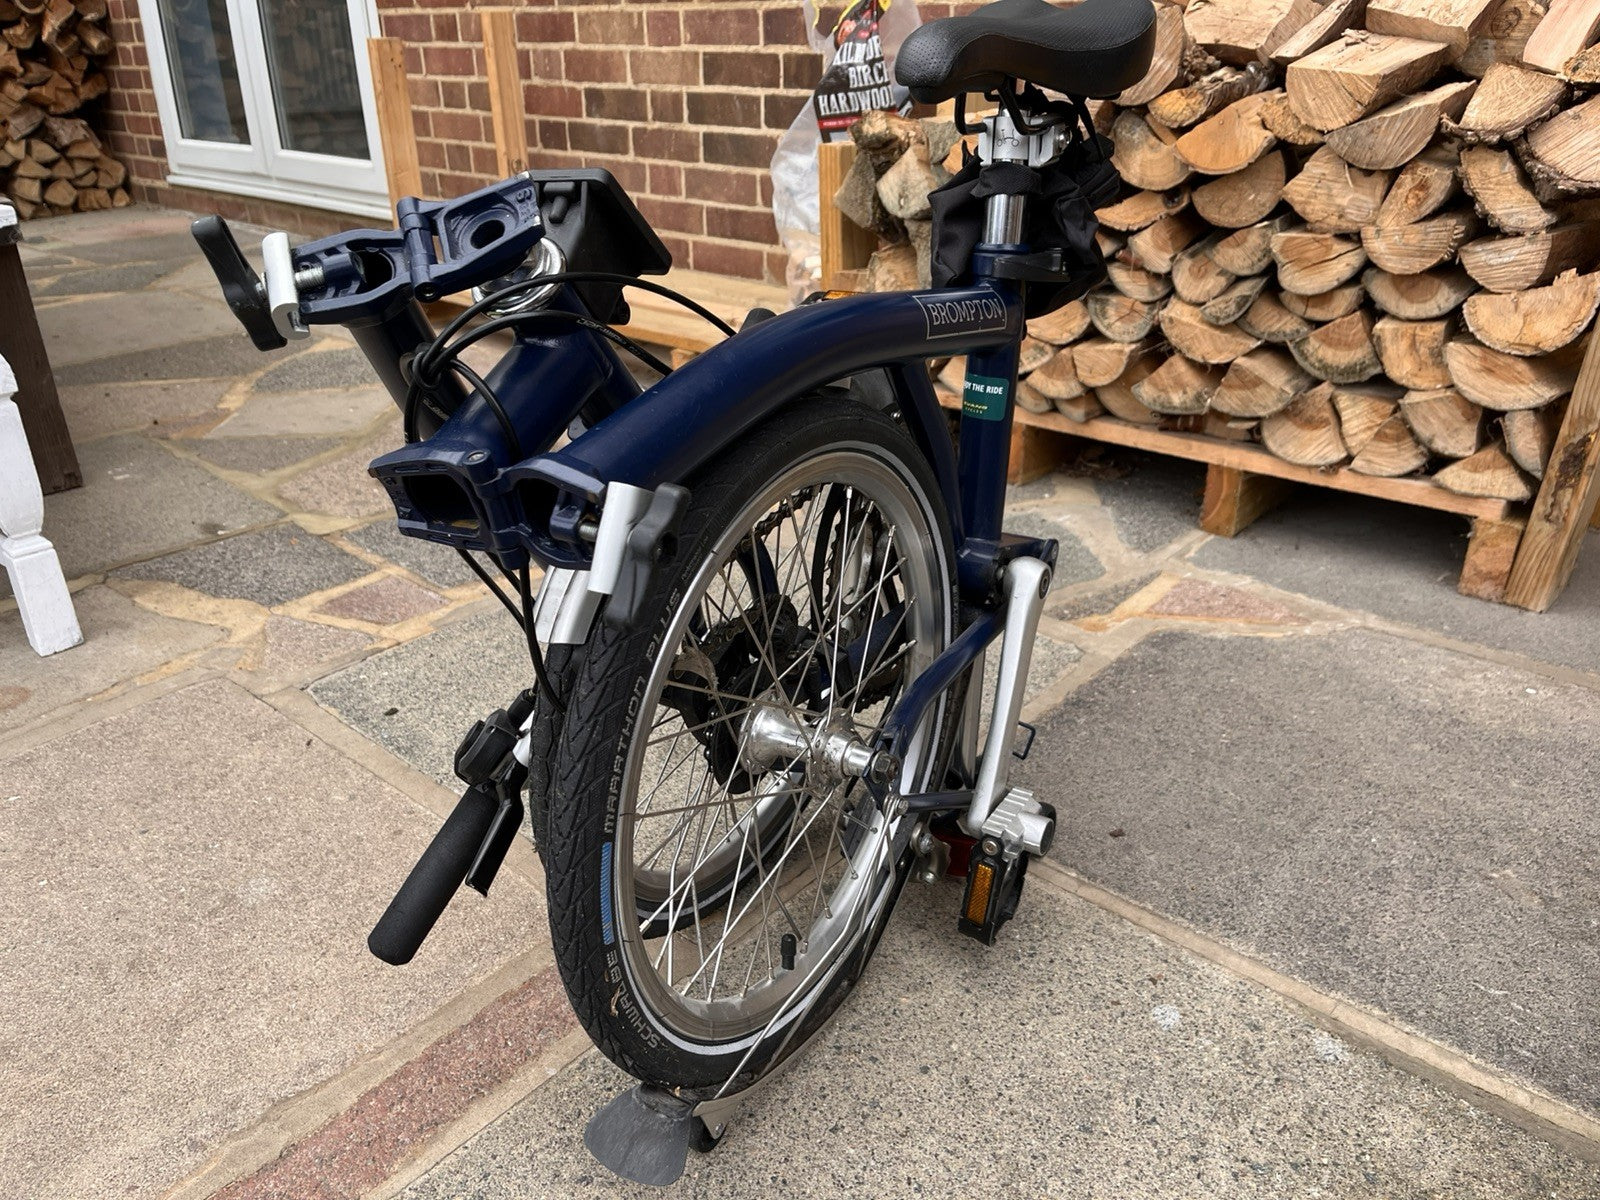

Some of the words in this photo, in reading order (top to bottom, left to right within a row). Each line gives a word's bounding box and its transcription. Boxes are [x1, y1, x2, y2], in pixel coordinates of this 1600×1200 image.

[927, 298, 1003, 325] BROMPTON
[972, 382, 985, 393] THE
[986, 385, 1004, 395] RIDE
[645, 587, 680, 662] PLUS
[606, 949, 661, 1049] SCHWALBE
